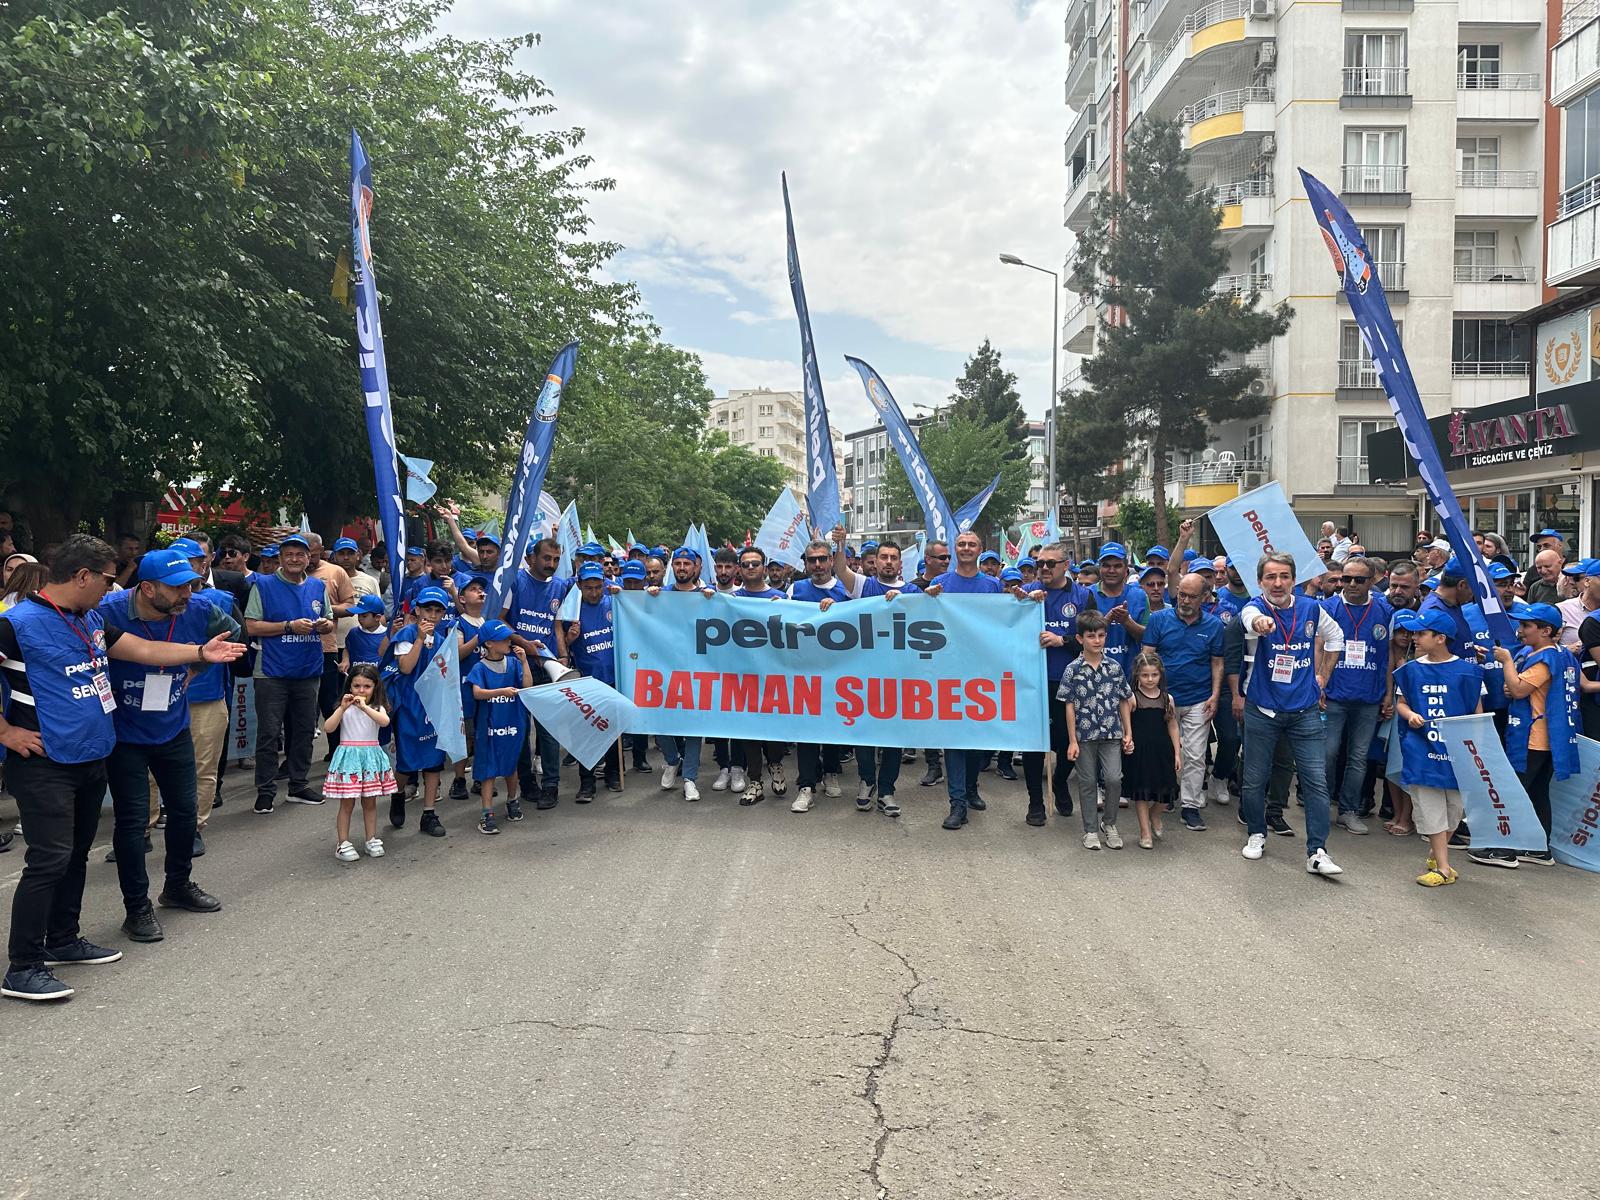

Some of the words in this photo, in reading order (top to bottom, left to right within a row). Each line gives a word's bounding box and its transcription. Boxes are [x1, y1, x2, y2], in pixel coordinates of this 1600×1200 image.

[1472, 449, 1513, 466] ZÜCCACİYE
[1516, 447, 1527, 459] VE
[1528, 442, 1553, 461] ÇEYİZ
[516, 621, 551, 635] SENDİKAS
[694, 613, 947, 661] petrol-iş
[633, 669, 822, 716] BATMAN
[835, 671, 1017, 726] ŞUBESİ
[1422, 685, 1448, 694] SEN
[1428, 709, 1446, 718] KA
[1462, 739, 1511, 837] petrol-iş
